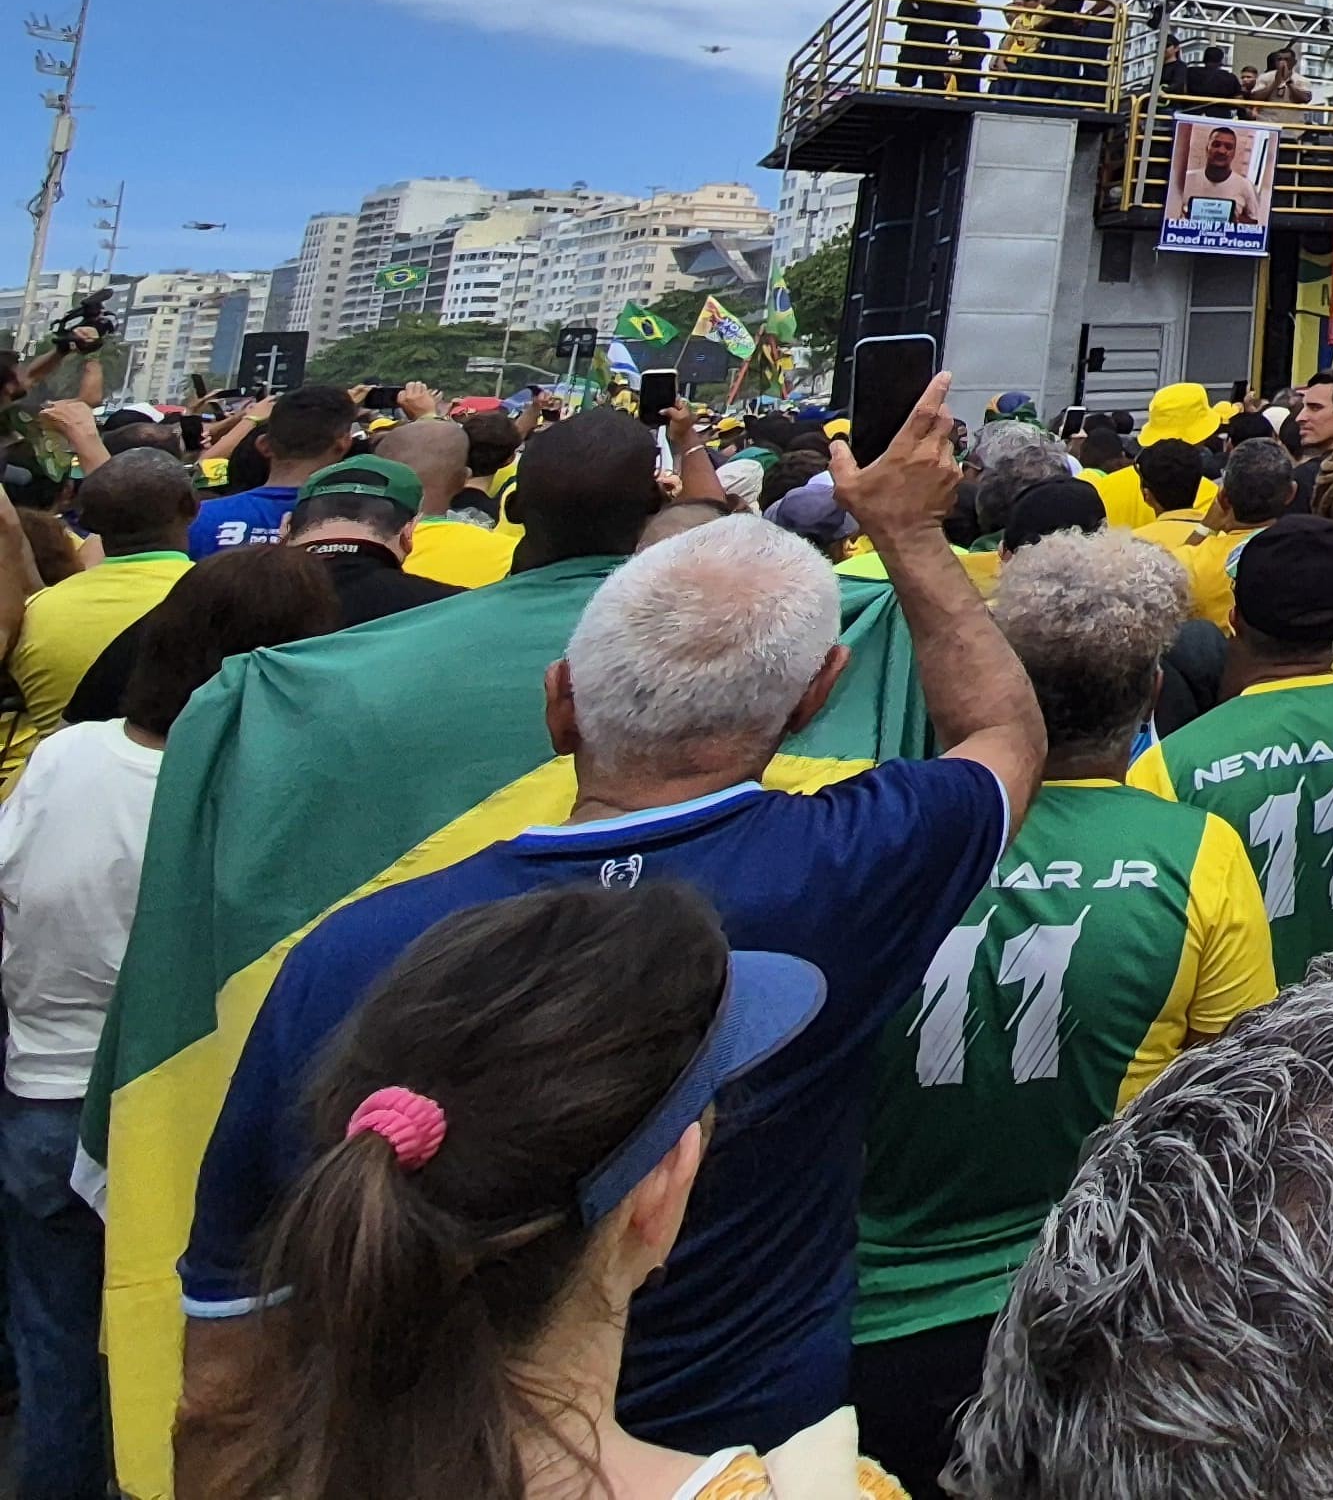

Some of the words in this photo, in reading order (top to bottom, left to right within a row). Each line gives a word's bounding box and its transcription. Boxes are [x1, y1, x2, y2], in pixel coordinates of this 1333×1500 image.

[1166, 233, 1200, 244] Dead
[1203, 236, 1215, 245] in
[1219, 237, 1260, 248] Prison
[306, 544, 359, 554] Canon
[1092, 859, 1160, 888] JR
[906, 904, 1092, 1088] 11
